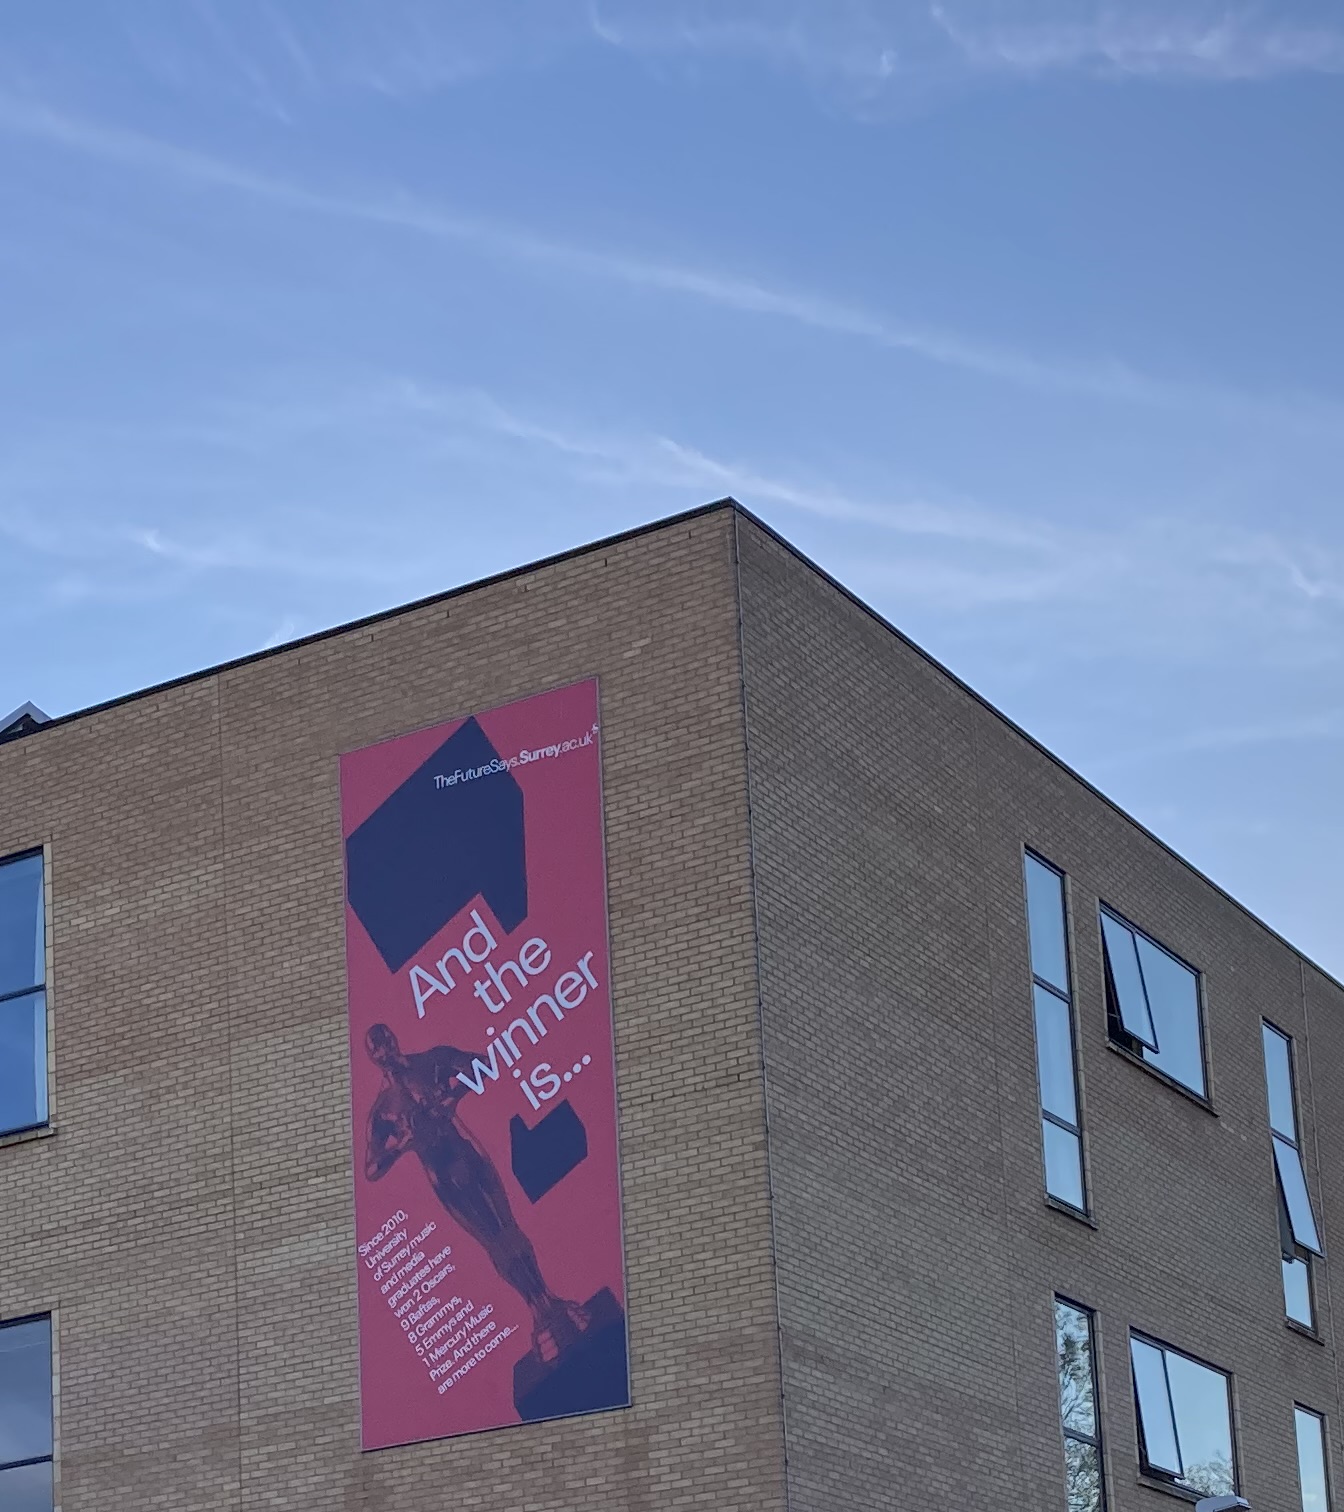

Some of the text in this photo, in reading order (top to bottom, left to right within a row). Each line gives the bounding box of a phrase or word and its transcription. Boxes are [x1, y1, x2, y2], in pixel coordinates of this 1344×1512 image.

[433, 731, 594, 790] TheFutureSays.Surrey.ac.uk
[409, 909, 498, 1019] And
[474, 937, 551, 1013] the
[456, 951, 598, 1095] winner
[512, 1054, 592, 1110] is...
[358, 1210, 408, 1257] Since 2010,
[365, 1229, 408, 1269] University
[373, 1221, 437, 1281] of Surrey music
[380, 1251, 425, 1295] and media
[388, 1246, 452, 1309] graduates have
[394, 1263, 455, 1318] won 2 Oscars,
[400, 1296, 441, 1331] 9 Baftas,
[407, 1296, 463, 1344] 8 Grammys,
[415, 1299, 474, 1356] 5 Emmys and
[422, 1304, 494, 1368] 1 Mercury Music
[429, 1321, 496, 1381] Prize. And there
[437, 1324, 519, 1395] are more to come...
